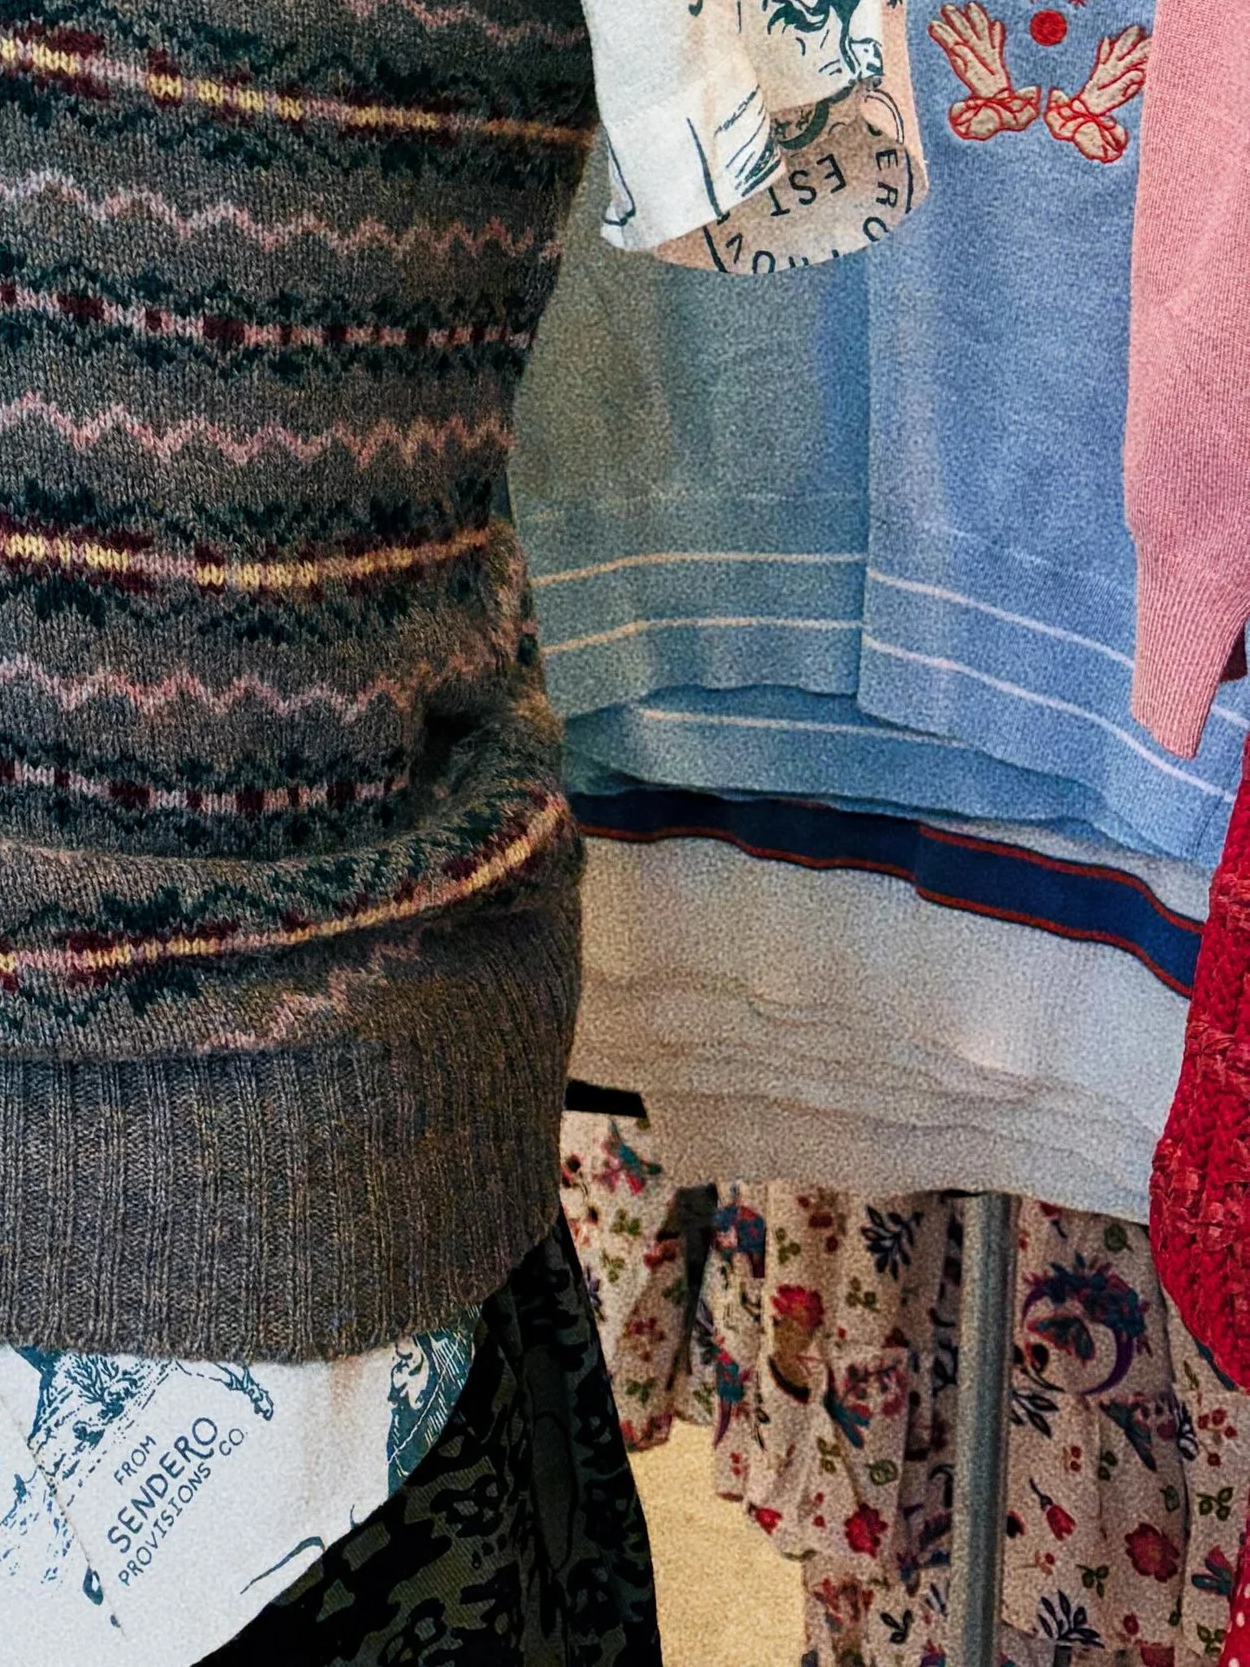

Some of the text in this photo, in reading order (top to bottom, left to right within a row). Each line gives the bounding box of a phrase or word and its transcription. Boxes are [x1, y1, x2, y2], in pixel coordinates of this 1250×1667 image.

[107, 1417, 218, 1554] SENDERO
[113, 1435, 157, 1485] FROM
[118, 1462, 212, 1586] PROVISIONS
